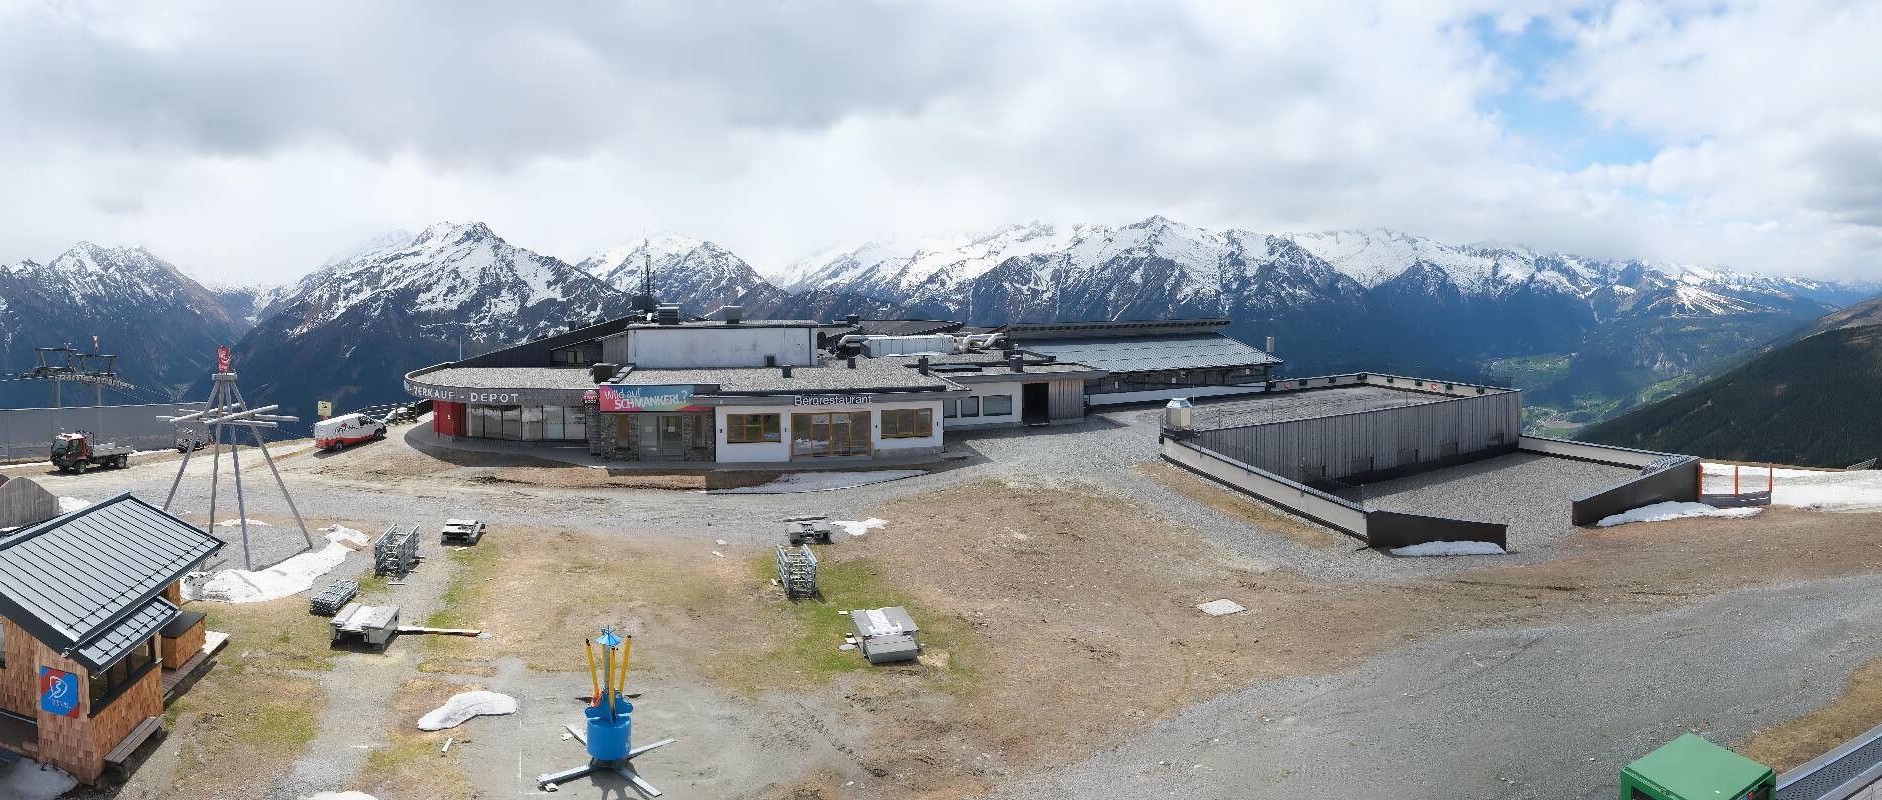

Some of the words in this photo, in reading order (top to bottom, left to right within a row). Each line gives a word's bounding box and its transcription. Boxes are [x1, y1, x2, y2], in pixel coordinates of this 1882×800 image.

[470, 392, 519, 403] DEPOT
[604, 388, 625, 400] Wild
[626, 387, 642, 398] auf
[615, 390, 688, 410] SCHMANKERL?
[794, 394, 872, 406] Bergrestaurant
